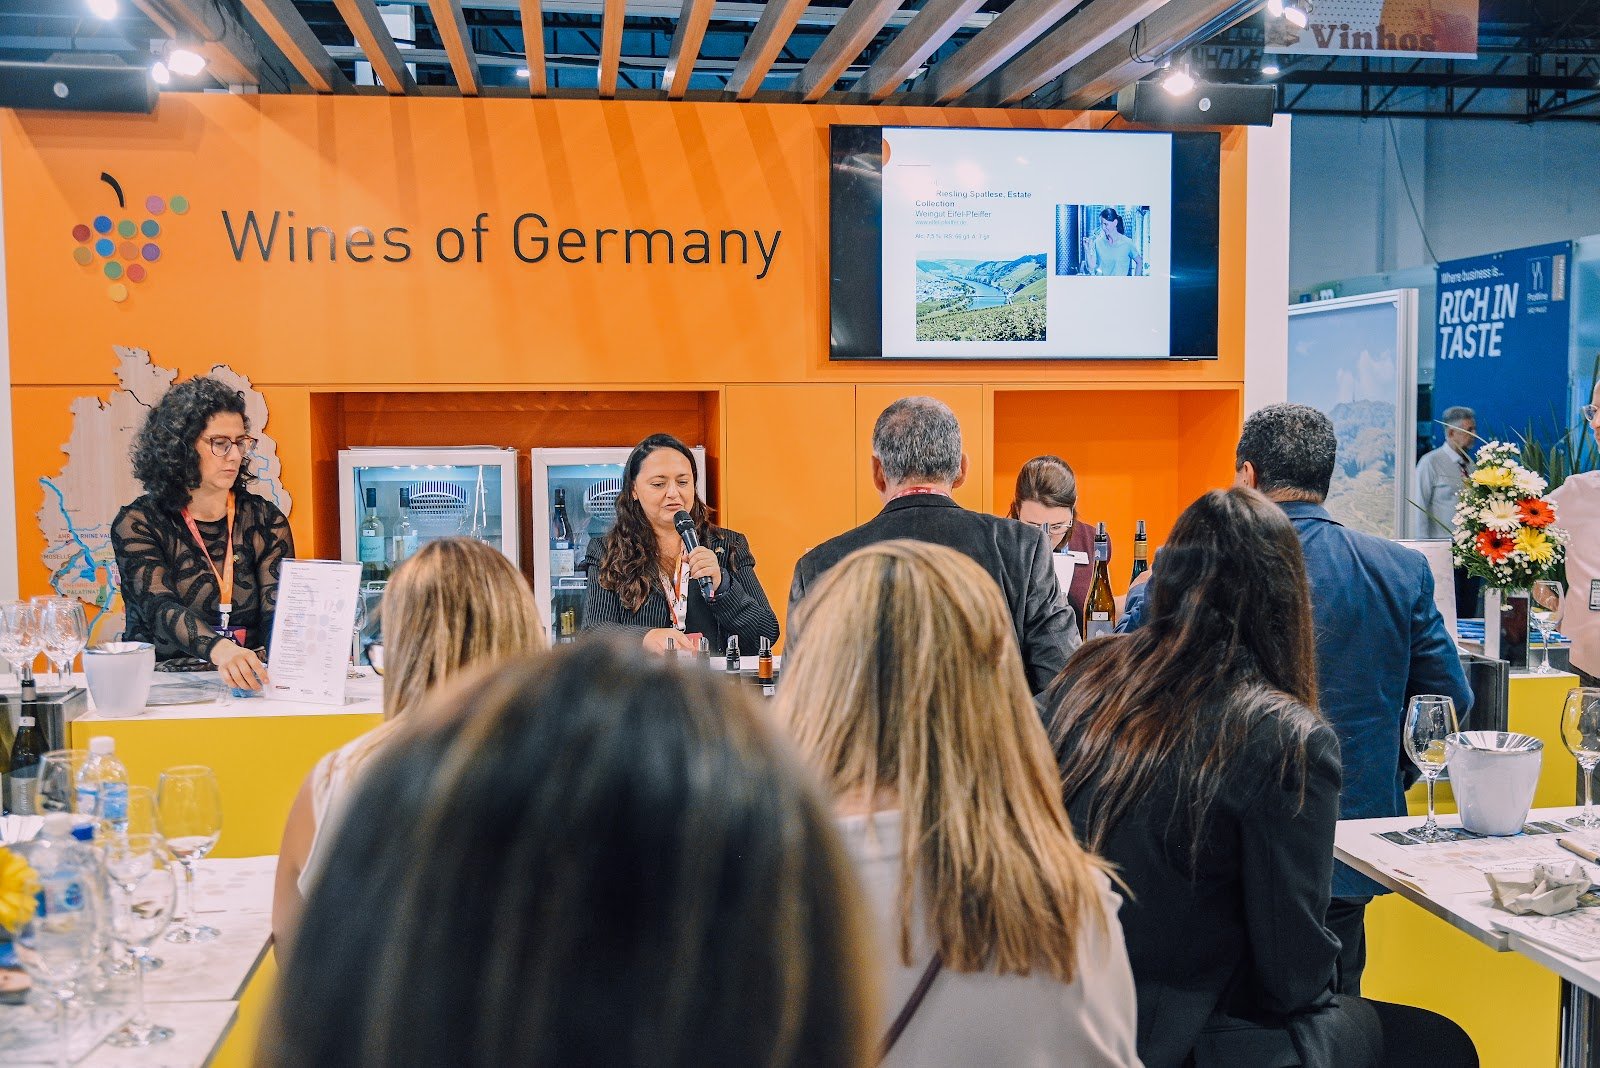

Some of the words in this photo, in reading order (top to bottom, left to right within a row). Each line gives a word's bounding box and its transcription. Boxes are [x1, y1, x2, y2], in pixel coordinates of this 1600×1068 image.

[1310, 23, 1437, 51] Vinhos
[936, 190, 968, 198] Riesling
[1007, 190, 1032, 198] Estate
[915, 210, 946, 219] Weingut
[947, 210, 992, 218] Eifel-Pfeiffer
[221, 209, 412, 264] Wines
[435, 212, 489, 264] of
[512, 212, 782, 280] Germany
[1440, 271, 1461, 284] Where
[1461, 268, 1491, 282] business
[1439, 285, 1490, 326] RICH
[1491, 282, 1520, 320] IN
[1440, 321, 1504, 360] TASTE
